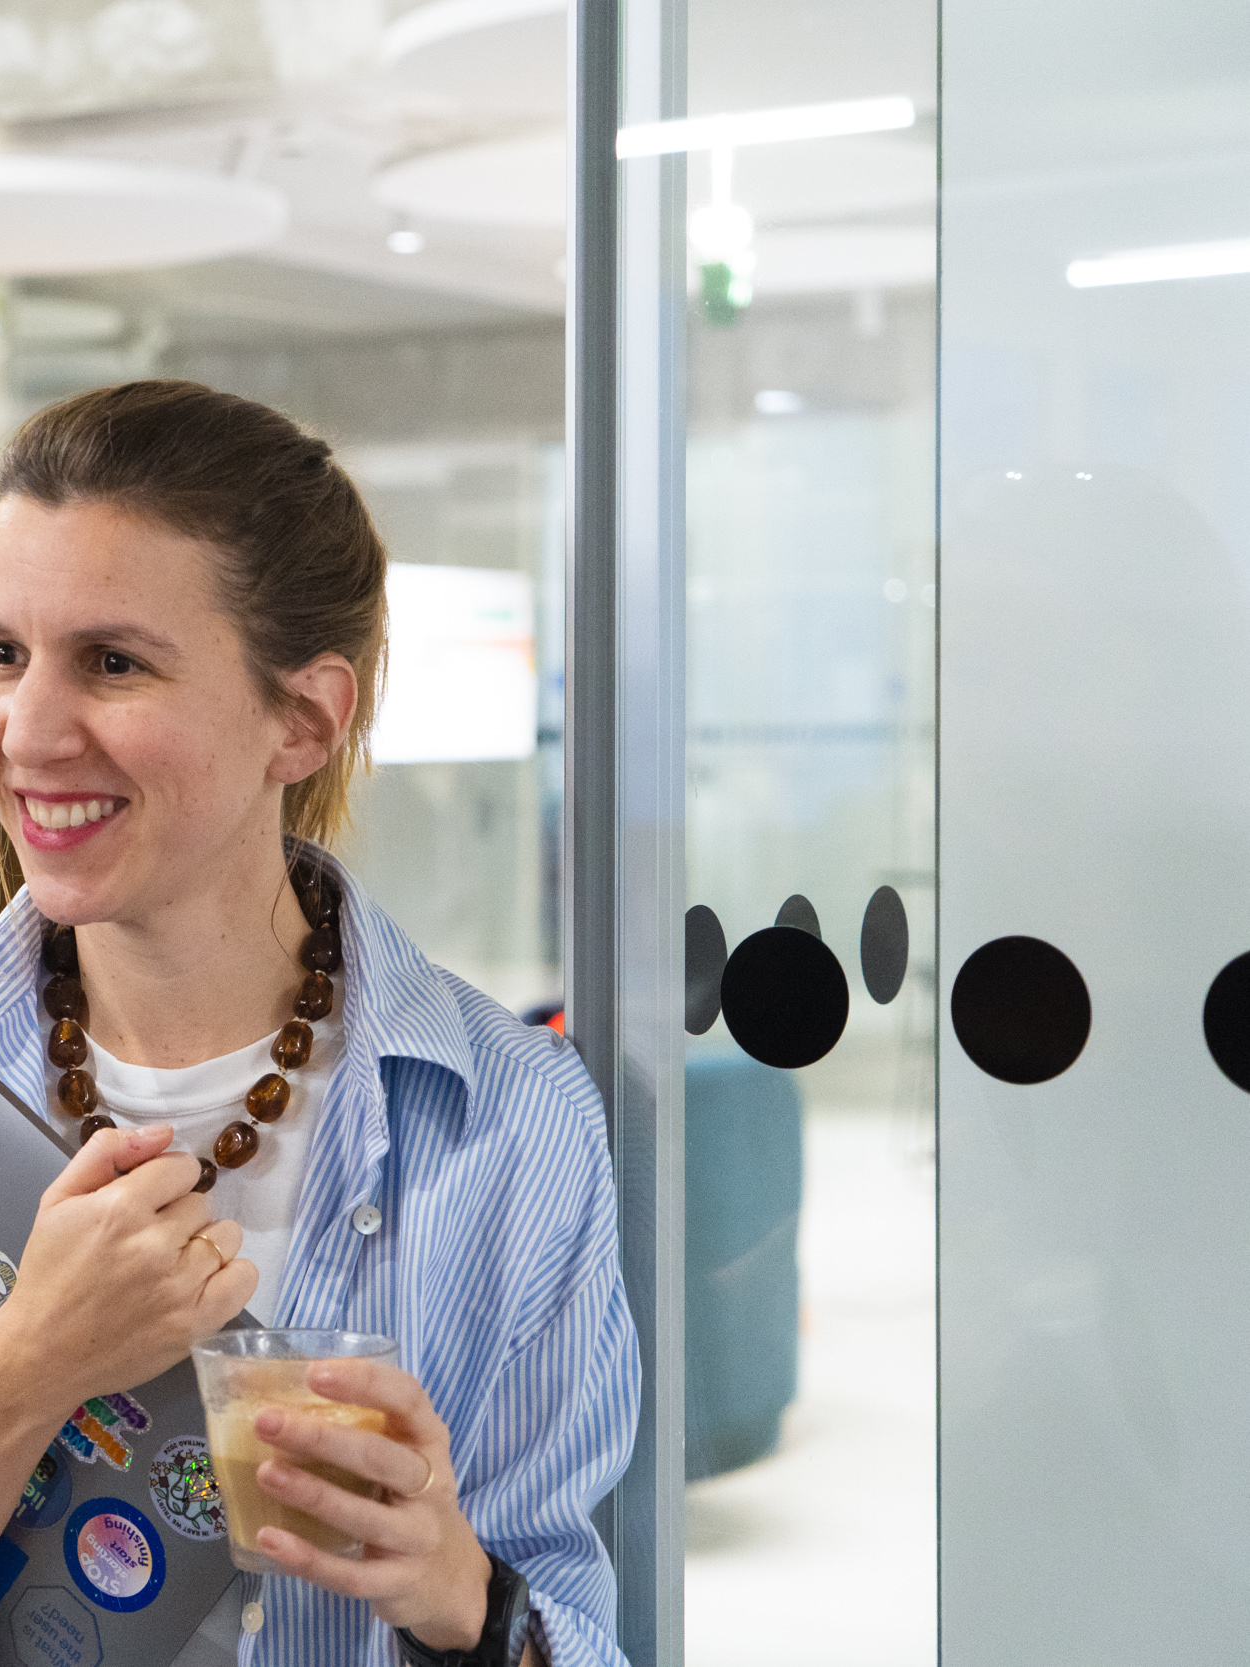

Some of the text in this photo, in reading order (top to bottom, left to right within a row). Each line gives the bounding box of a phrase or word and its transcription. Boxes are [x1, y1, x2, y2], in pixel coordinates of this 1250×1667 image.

[178, 1440, 206, 1448] ANTRAG
[156, 1498, 172, 1520] TRUST
[171, 1519, 182, 1529] WE
[85, 1533, 128, 1579] starting
[104, 1516, 149, 1567] finishing
[109, 1540, 138, 1569] start
[80, 1552, 121, 1595] STOP
[22, 1624, 36, 1639] is
[28, 1609, 81, 1664] the user
[40, 1602, 85, 1645] need?
